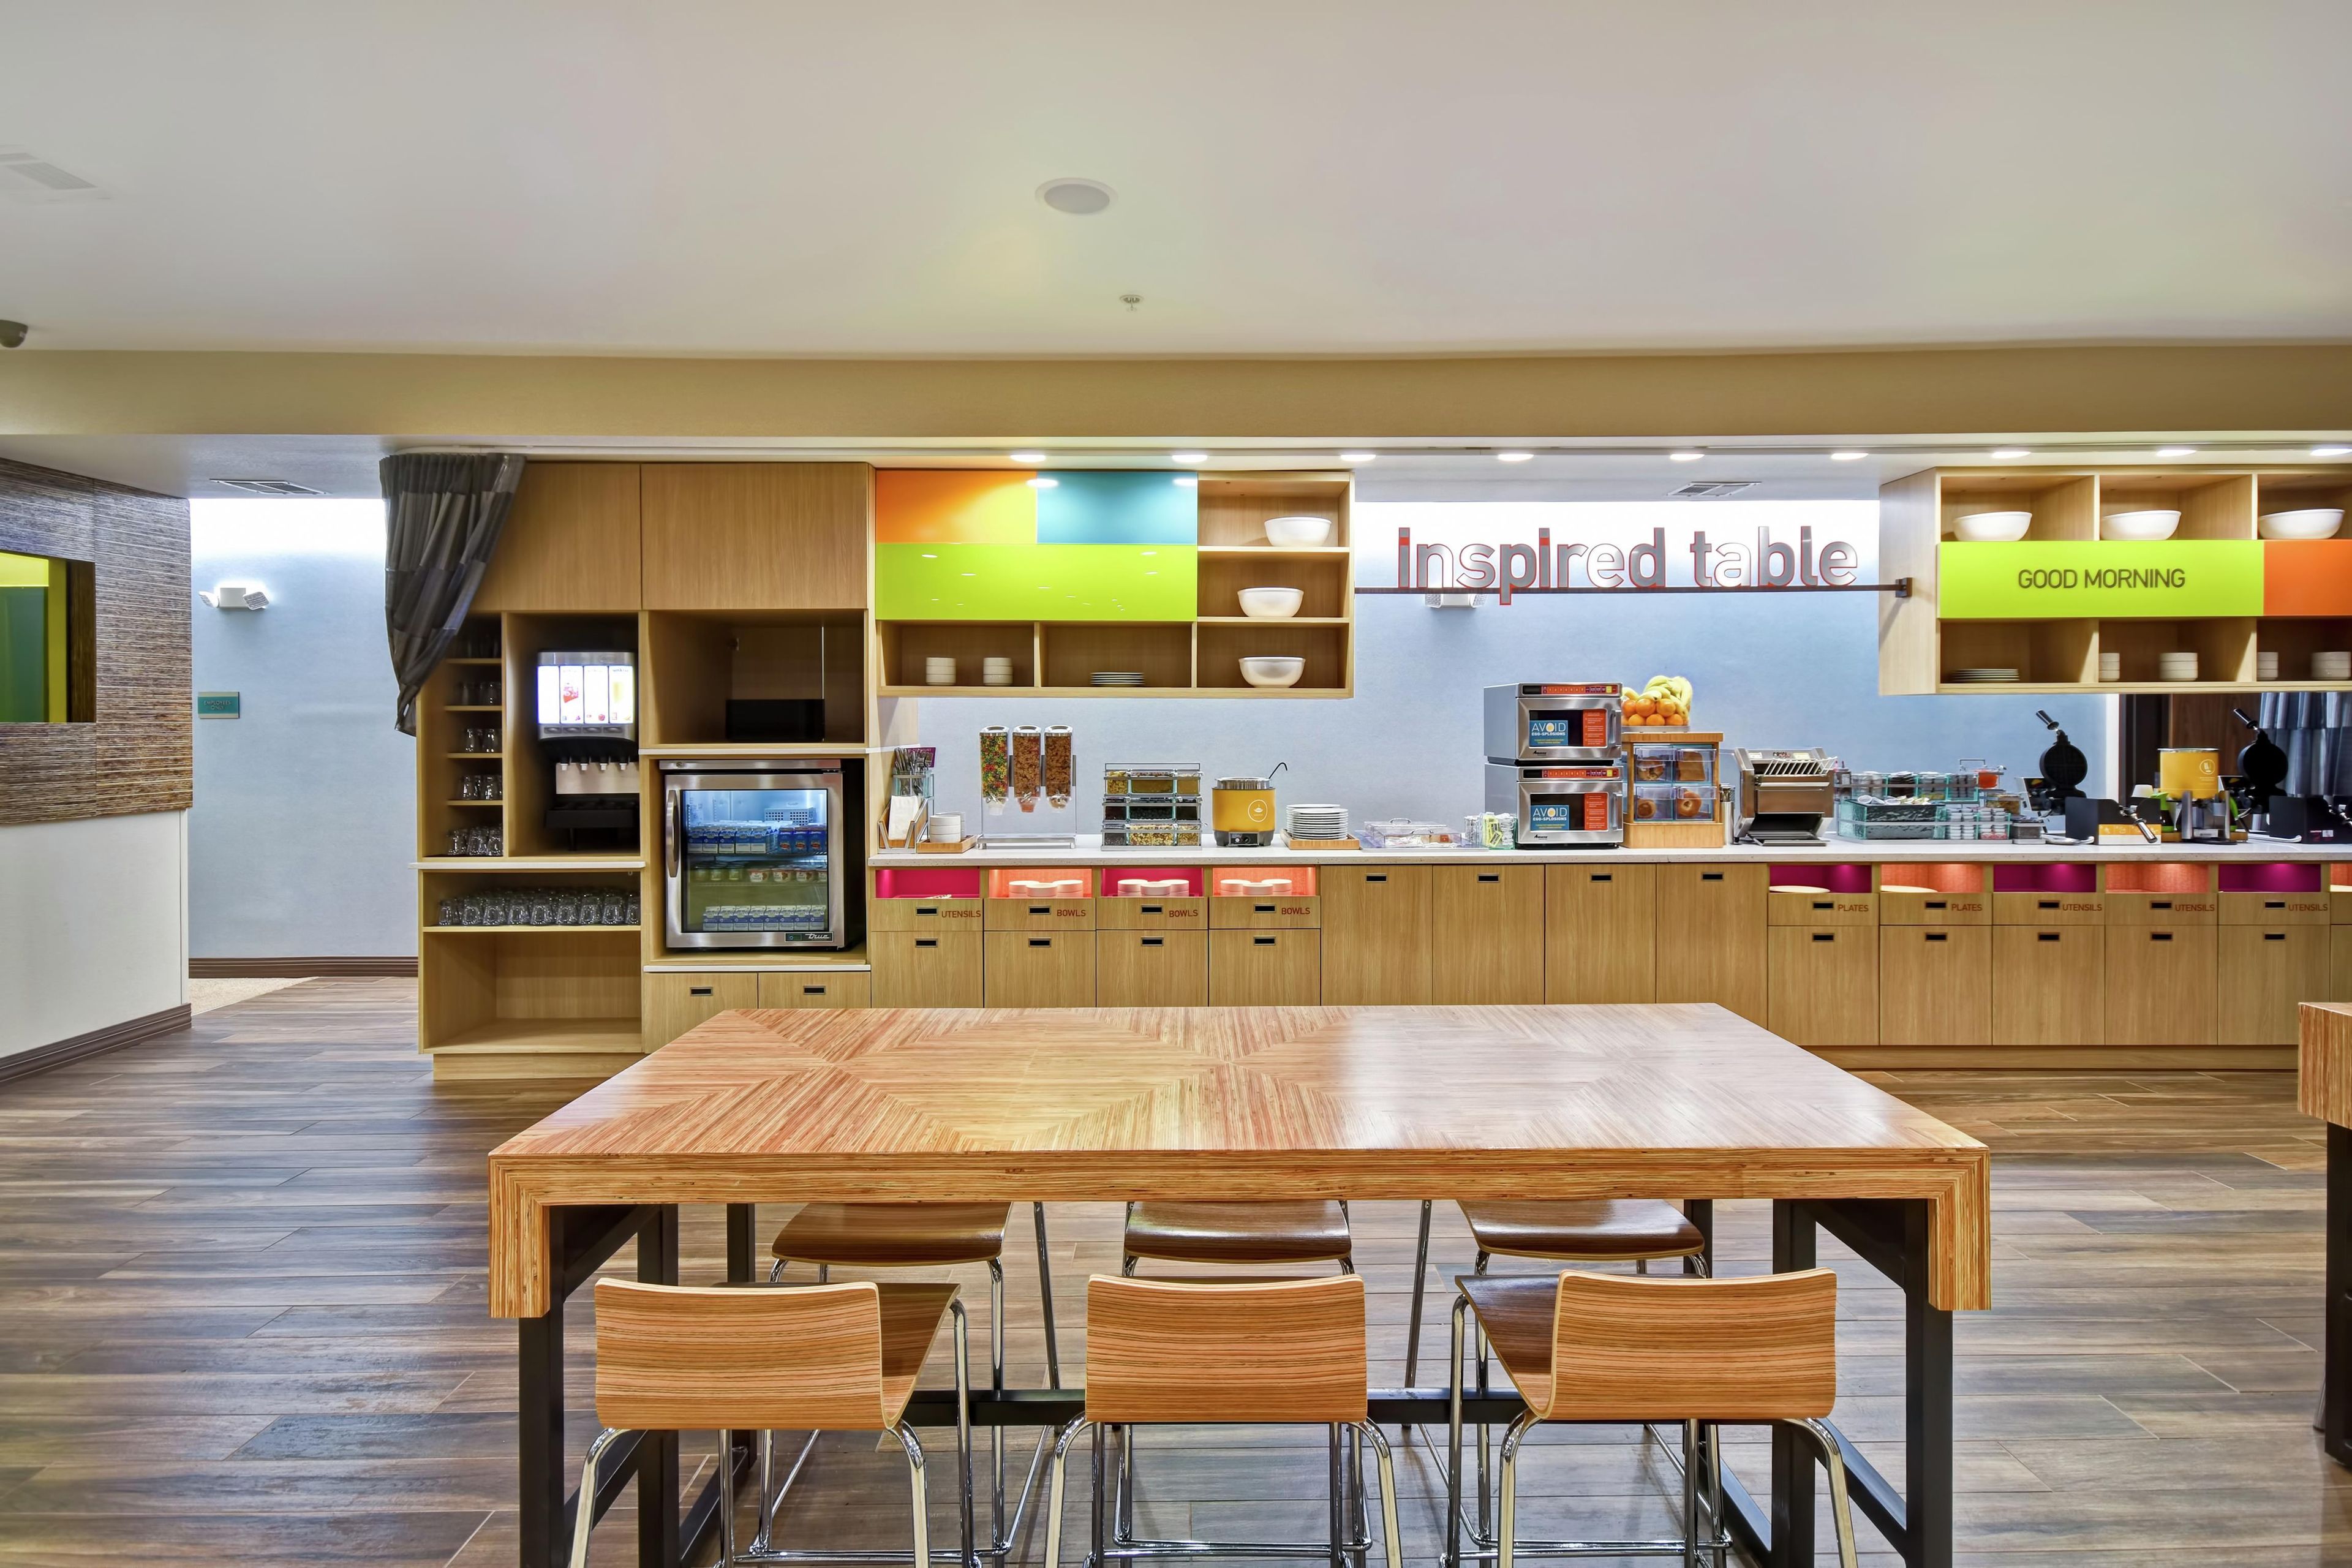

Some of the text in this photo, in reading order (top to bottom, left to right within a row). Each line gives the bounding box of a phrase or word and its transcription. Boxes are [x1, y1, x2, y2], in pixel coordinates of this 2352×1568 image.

[1398, 526, 1858, 605] inspired table
[2018, 568, 2185, 589] GOOD MORNING
[1531, 722, 1566, 732] AVOID
[1532, 807, 1567, 817] AVOID
[1838, 903, 1869, 912] PLATES
[1169, 909, 1198, 918] BOWLS
